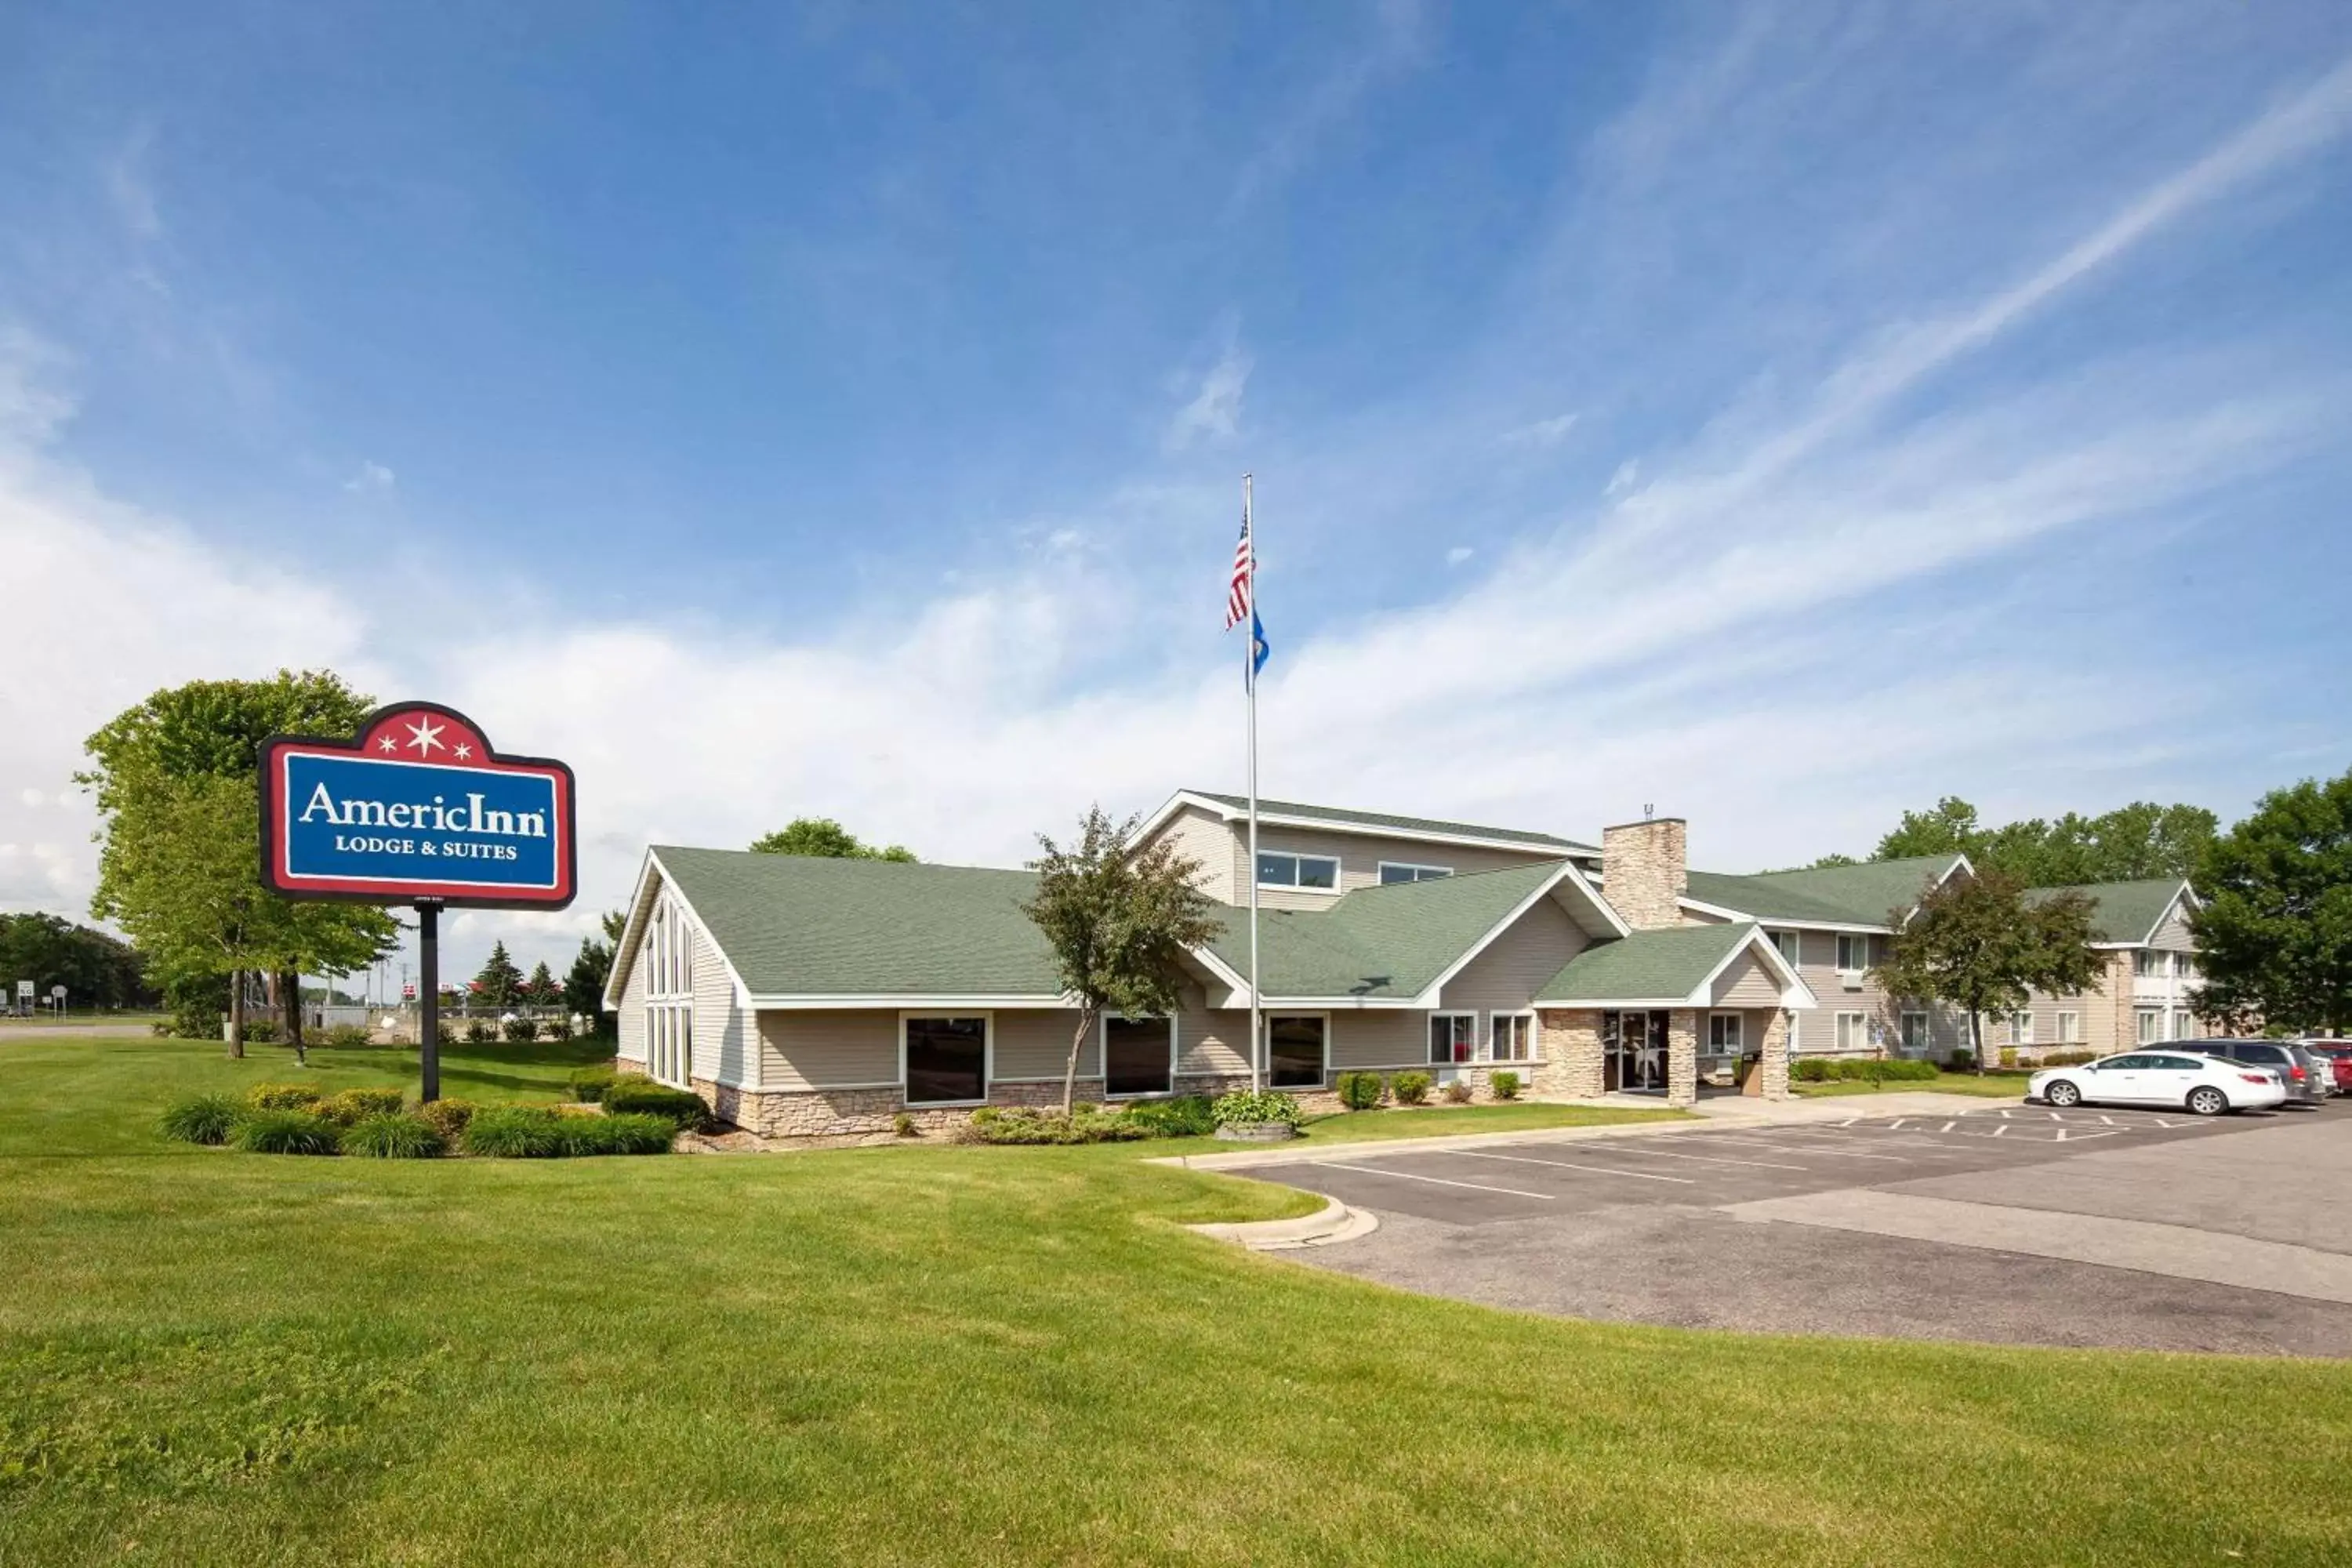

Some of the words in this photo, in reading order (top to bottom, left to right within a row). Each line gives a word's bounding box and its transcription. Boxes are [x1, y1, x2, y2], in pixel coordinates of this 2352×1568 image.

[299, 782, 546, 837] AmericInn
[336, 835, 415, 854] LODGE
[421, 840, 437, 855] &
[442, 841, 517, 860] SUITES
